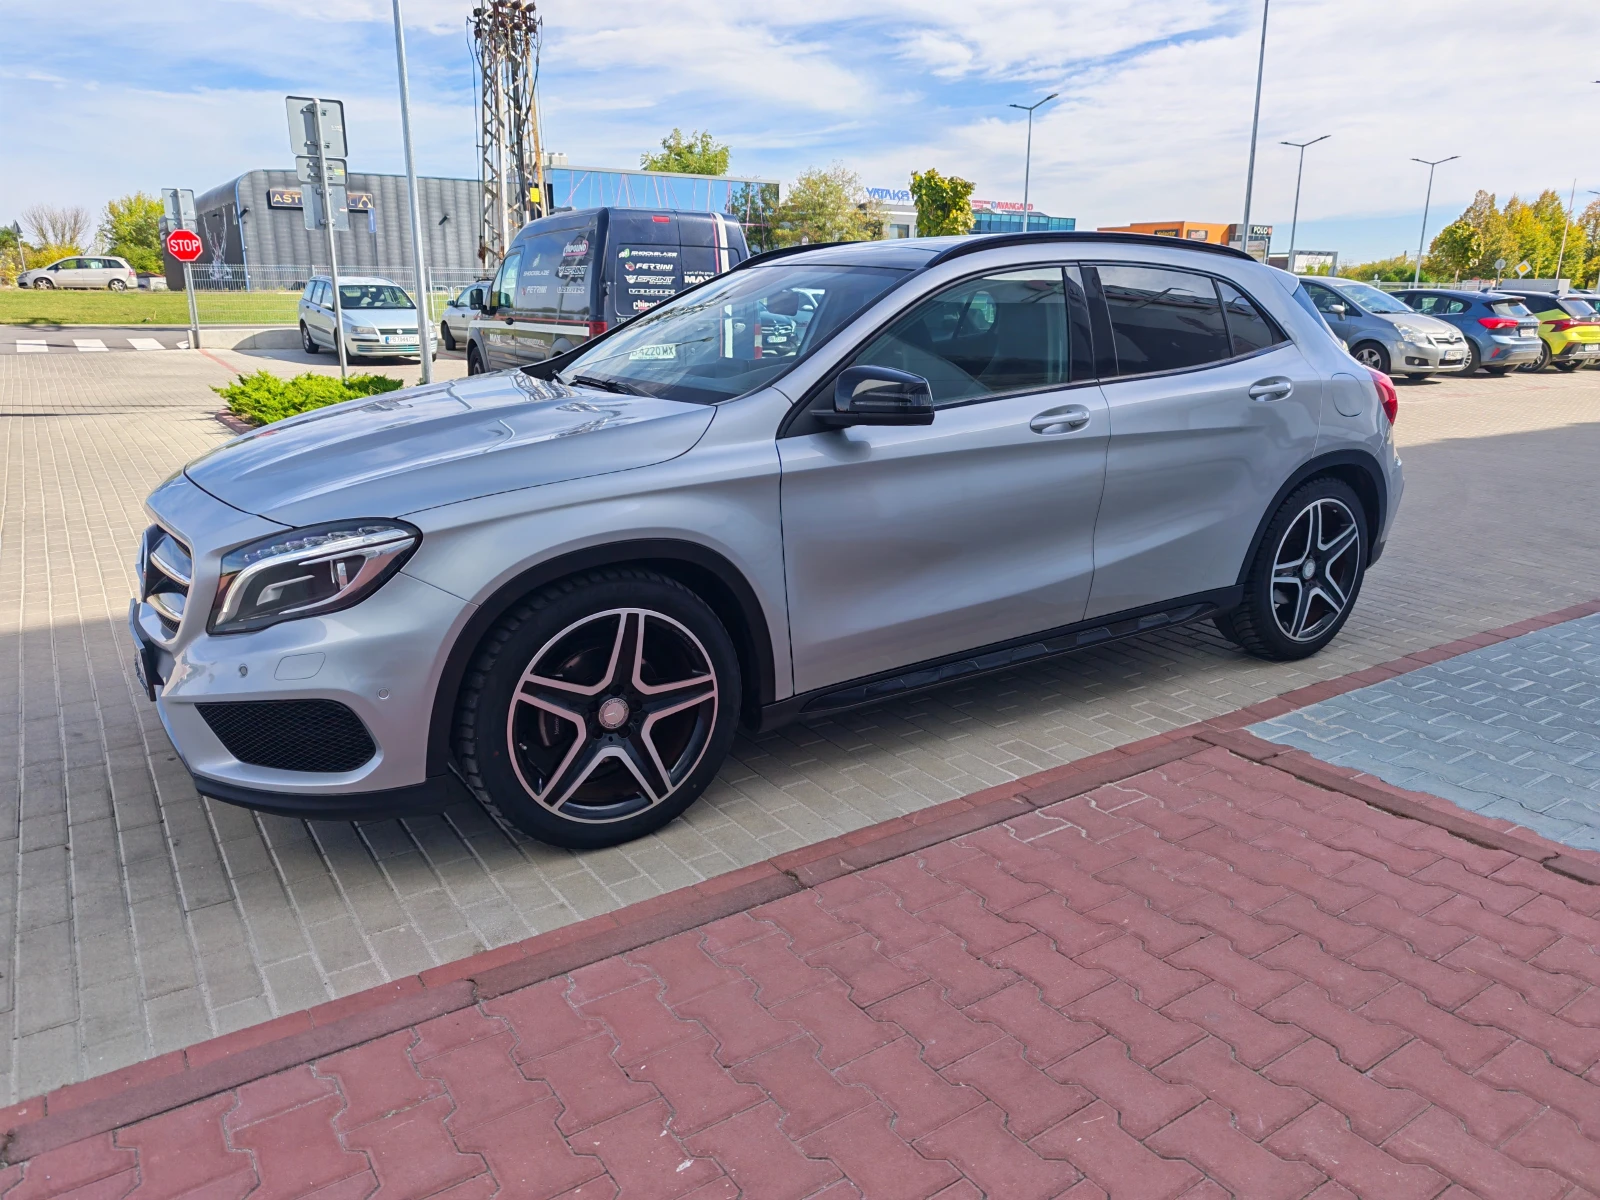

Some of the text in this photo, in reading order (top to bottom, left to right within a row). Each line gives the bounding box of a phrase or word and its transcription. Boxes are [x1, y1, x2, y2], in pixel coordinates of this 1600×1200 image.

[170, 239, 199, 252] STOP
[635, 262, 673, 270] FERRINI
[635, 275, 676, 283] SPRINT
[639, 346, 661, 356] 4220
[662, 346, 674, 356] MX
